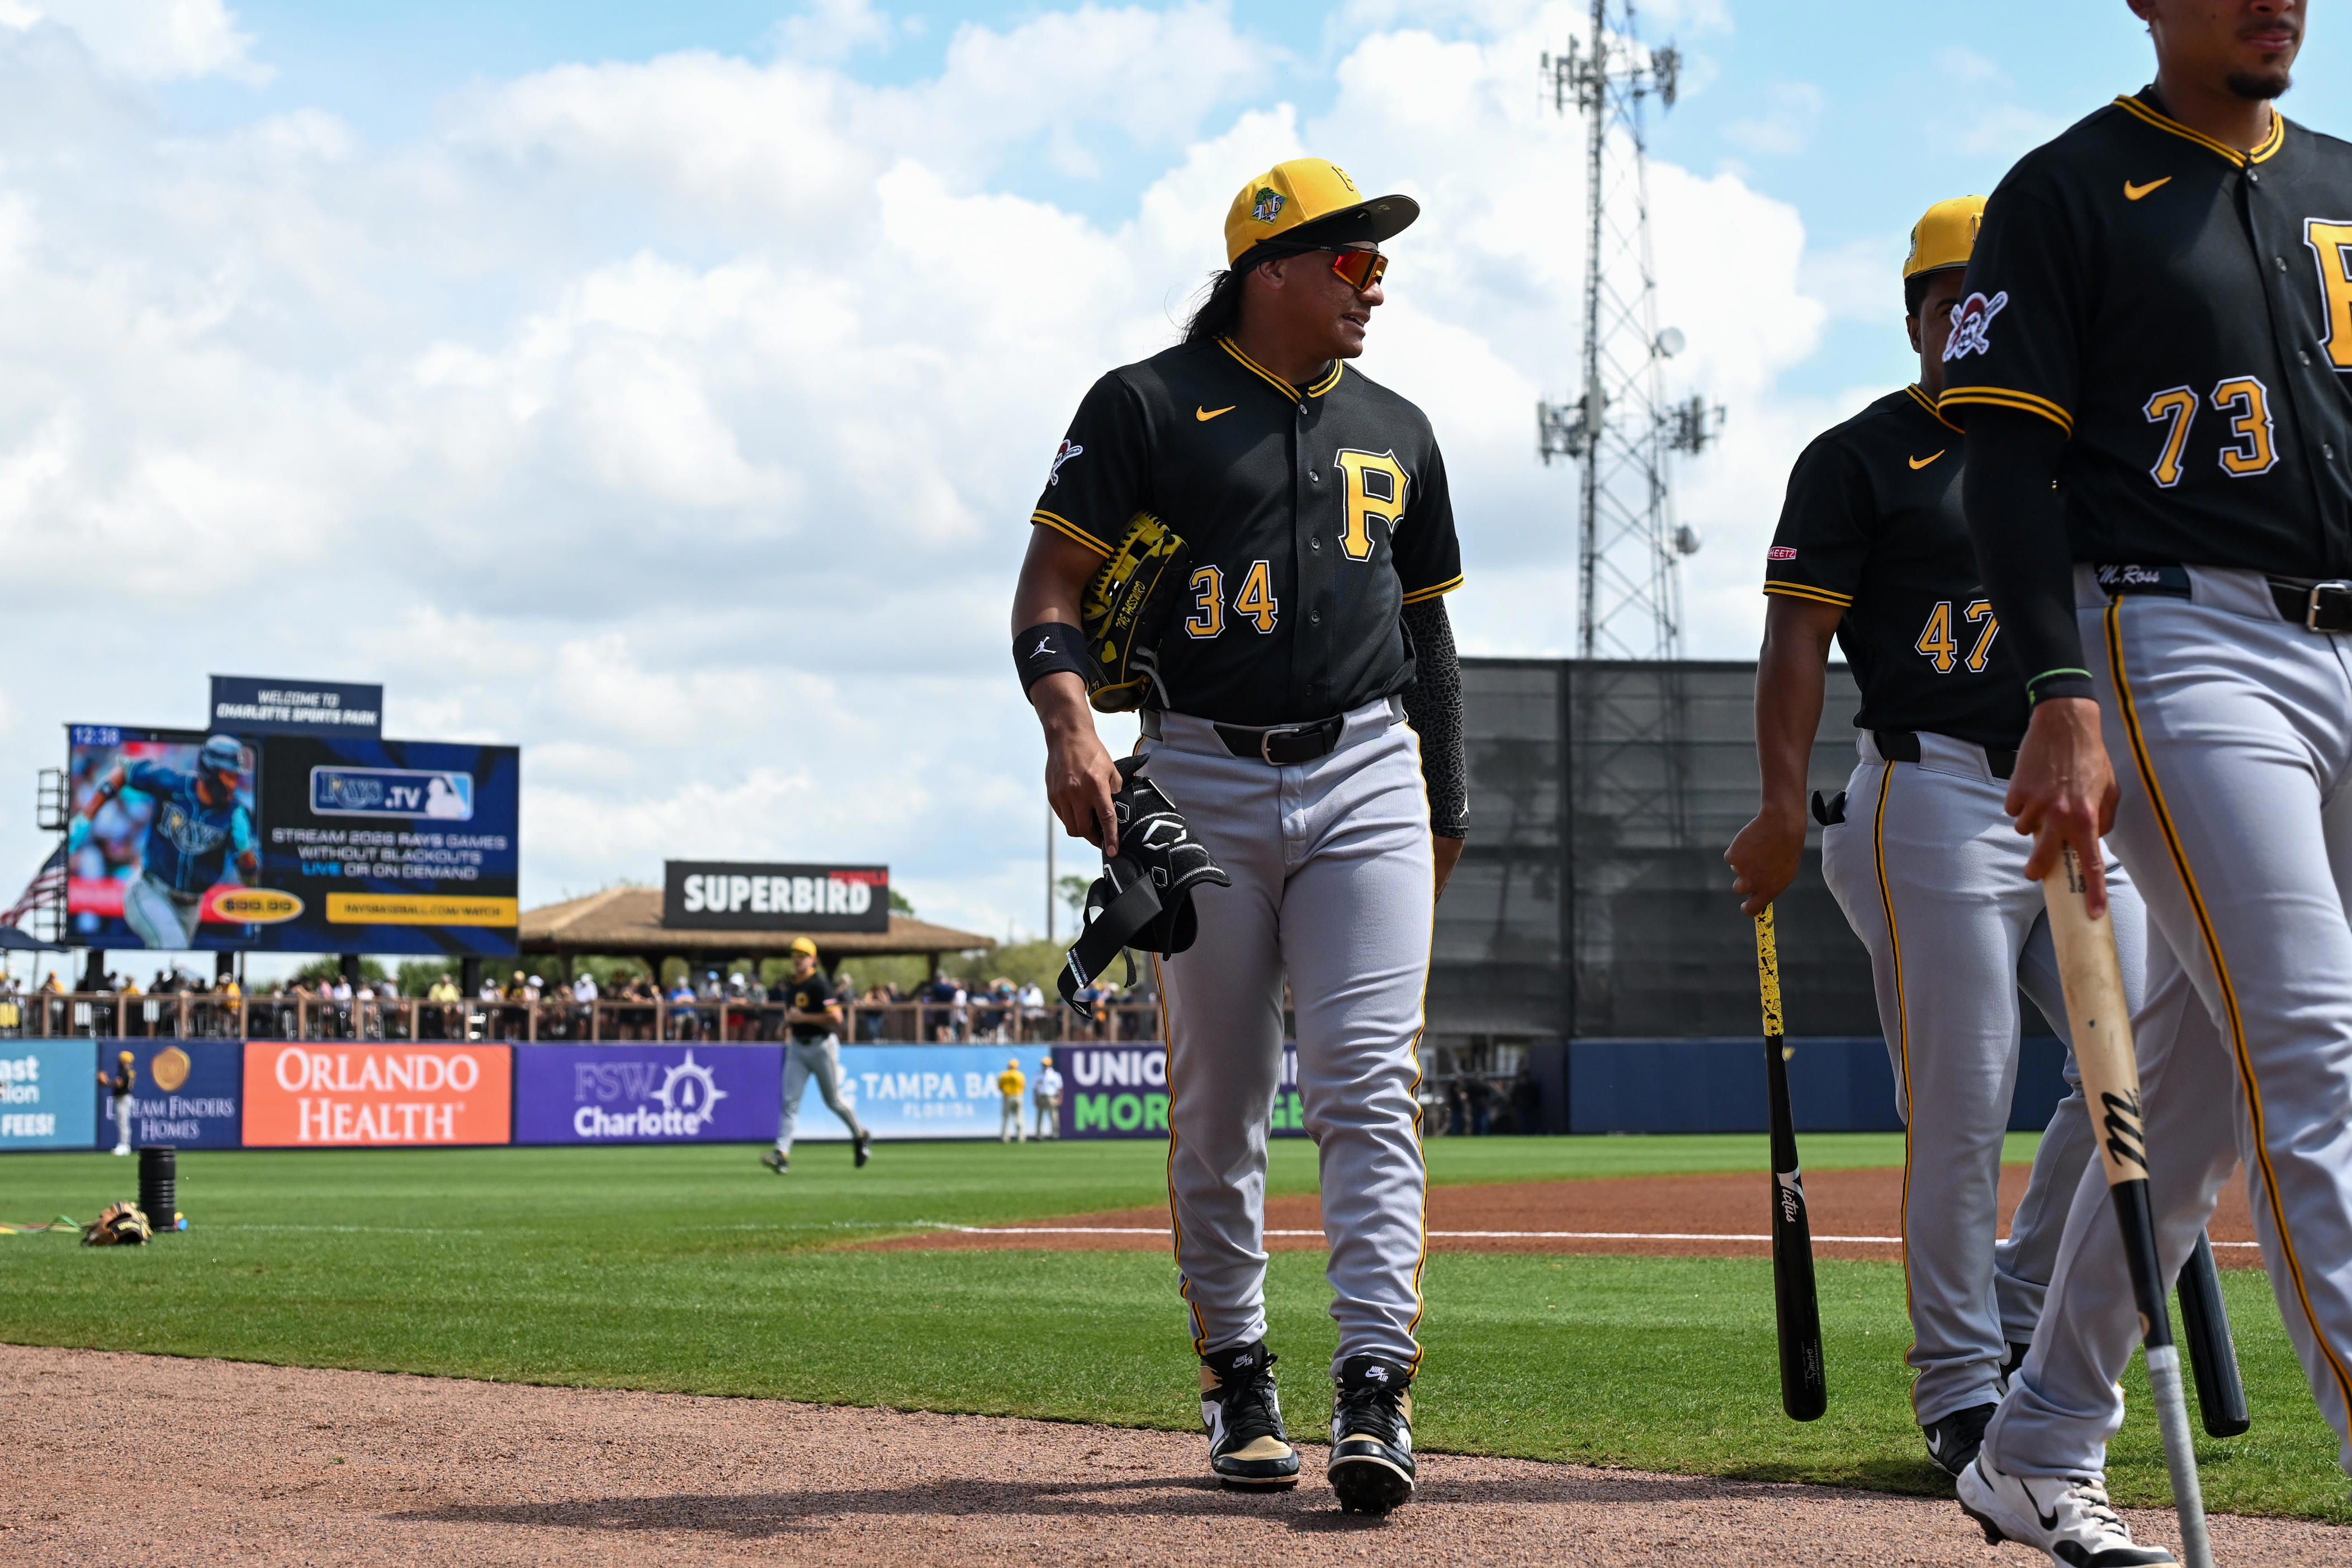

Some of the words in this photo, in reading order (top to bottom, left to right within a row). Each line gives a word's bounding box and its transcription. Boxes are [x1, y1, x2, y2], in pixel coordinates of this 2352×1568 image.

[2142, 375, 2279, 487] 73
[1334, 447, 1411, 562] P
[1185, 560, 1278, 639] 34
[1915, 599, 2000, 674] 47
[258, 689, 321, 707] WELCOME
[321, 692, 340, 708] TO
[216, 703, 291, 721] CHARLOTTE
[292, 707, 342, 724] SPORTS
[342, 709, 378, 726] PARK
[272, 827, 347, 844] STREAM
[397, 832, 443, 847] RAYS
[446, 834, 508, 850] GAMES
[298, 845, 376, 861] WITHOUT
[380, 847, 483, 865] BLACKOUTS
[301, 861, 342, 877] LIVE
[344, 863, 370, 877] OR
[372, 863, 399, 878] ON
[402, 864, 479, 880] DEMAND
[684, 874, 872, 915] SUPERBIRD
[275, 1047, 480, 1092] ORLANDO
[574, 1062, 659, 1102] FSW
[860, 1072, 958, 1100] TAMPA
[964, 1072, 1002, 1100] BA
[169, 1096, 235, 1118] FINDERS
[903, 1101, 976, 1118] FLORIDA
[1, 1112, 56, 1138] FEES!
[141, 1119, 200, 1141] HOMES
[296, 1097, 456, 1141] HEALTH
[574, 1105, 700, 1138] Charlotte
[1234, 1353, 1248, 1363] NIKE
[1244, 1357, 1253, 1367] AIR
[1369, 1365, 1385, 1374] NIKE
[1378, 1374, 1389, 1383] AIR
